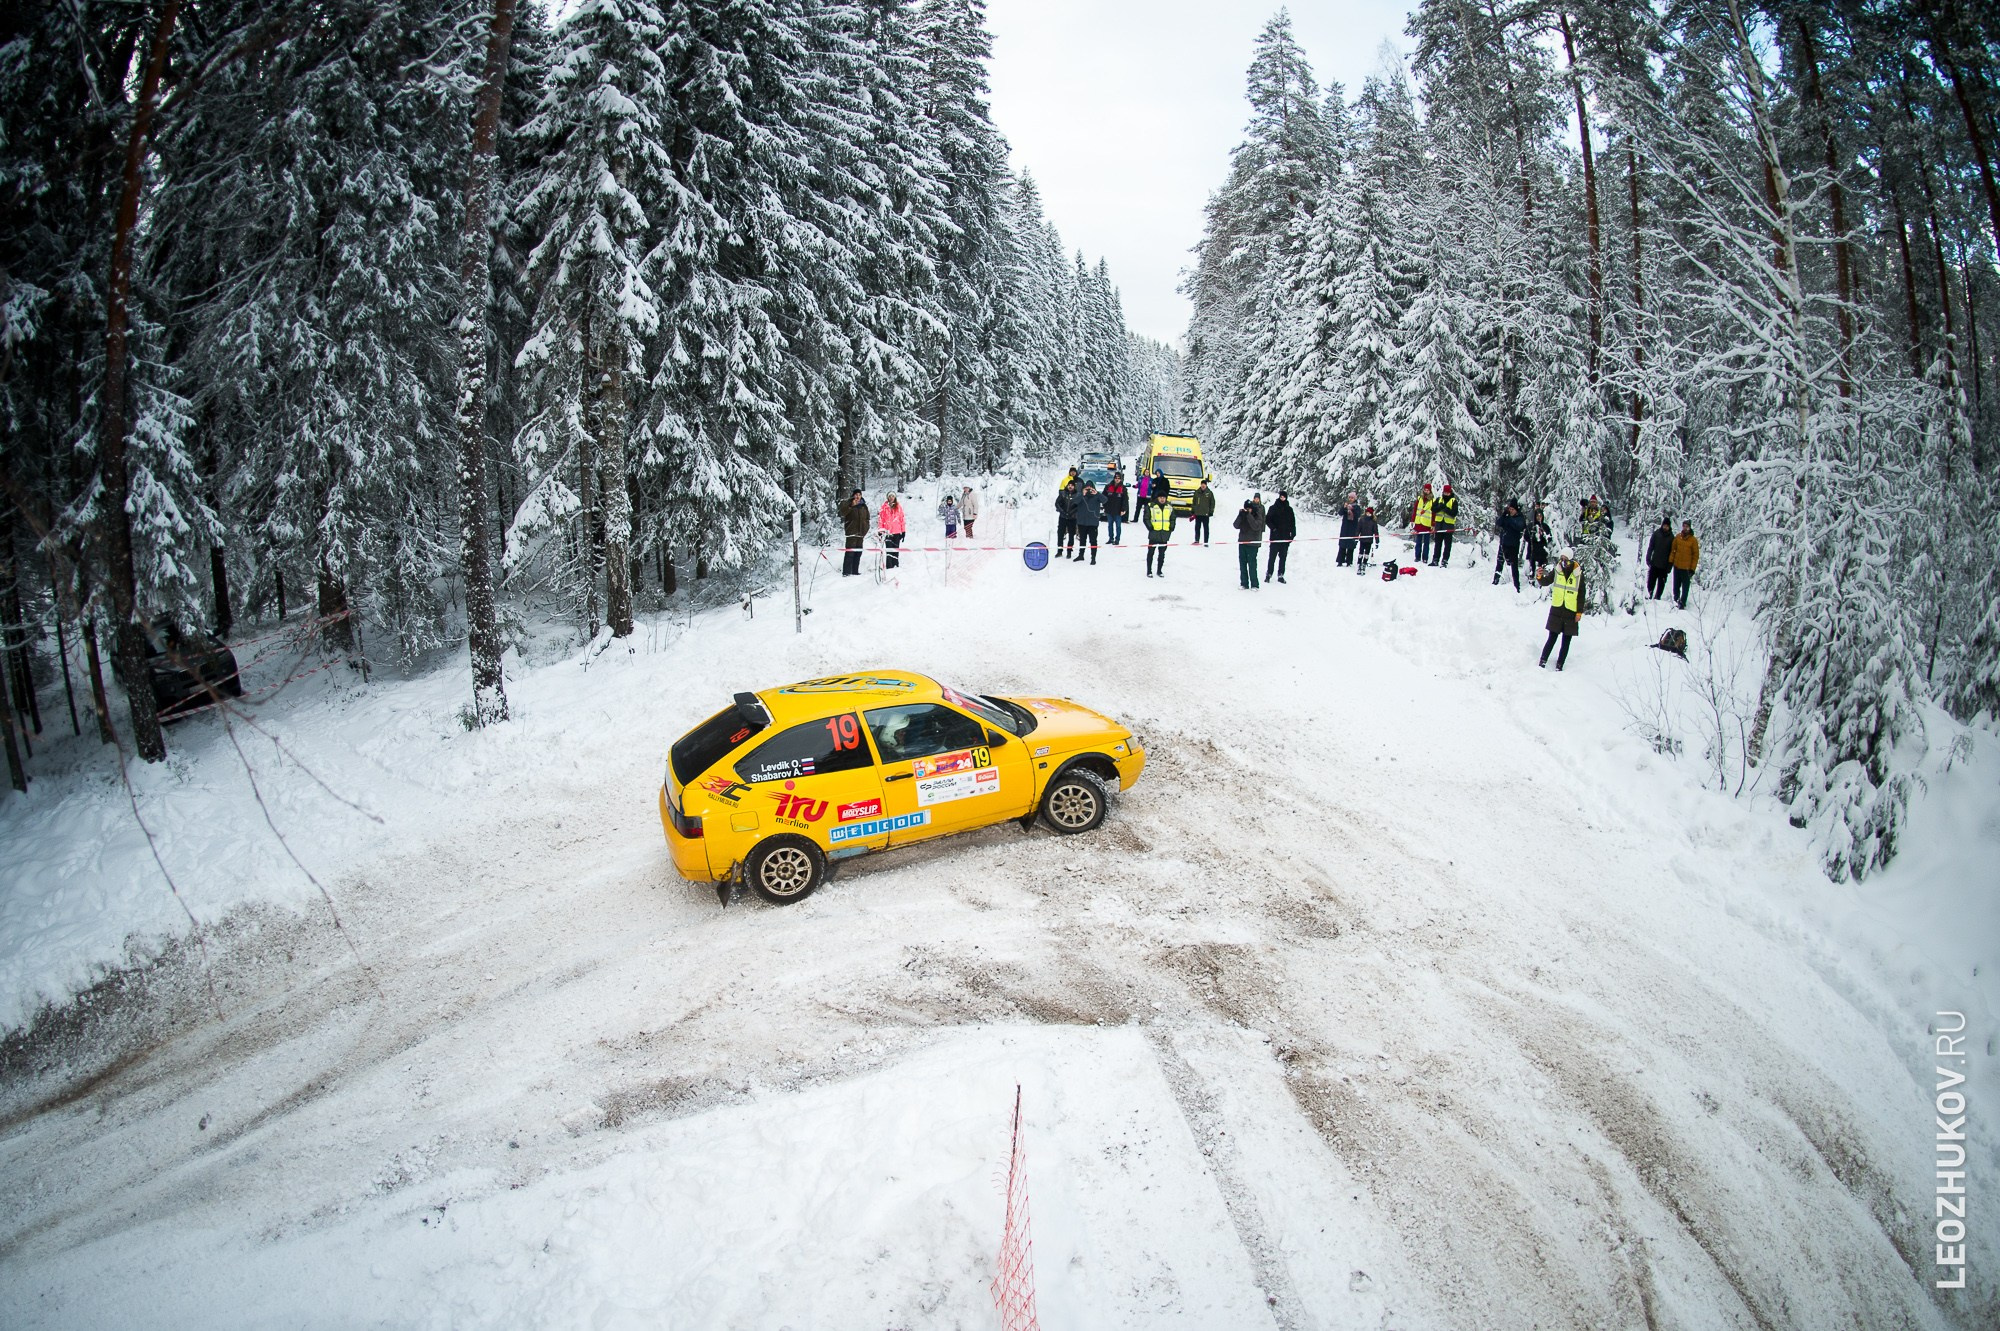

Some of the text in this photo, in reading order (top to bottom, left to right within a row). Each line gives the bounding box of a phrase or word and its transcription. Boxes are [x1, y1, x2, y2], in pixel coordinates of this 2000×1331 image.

[826, 715, 860, 751] 19
[957, 757, 973, 770] 24
[973, 747, 990, 768] 19
[761, 759, 802, 773] Levdik O.
[751, 768, 803, 783] Shabarov A.
[776, 816, 810, 830] merlion
